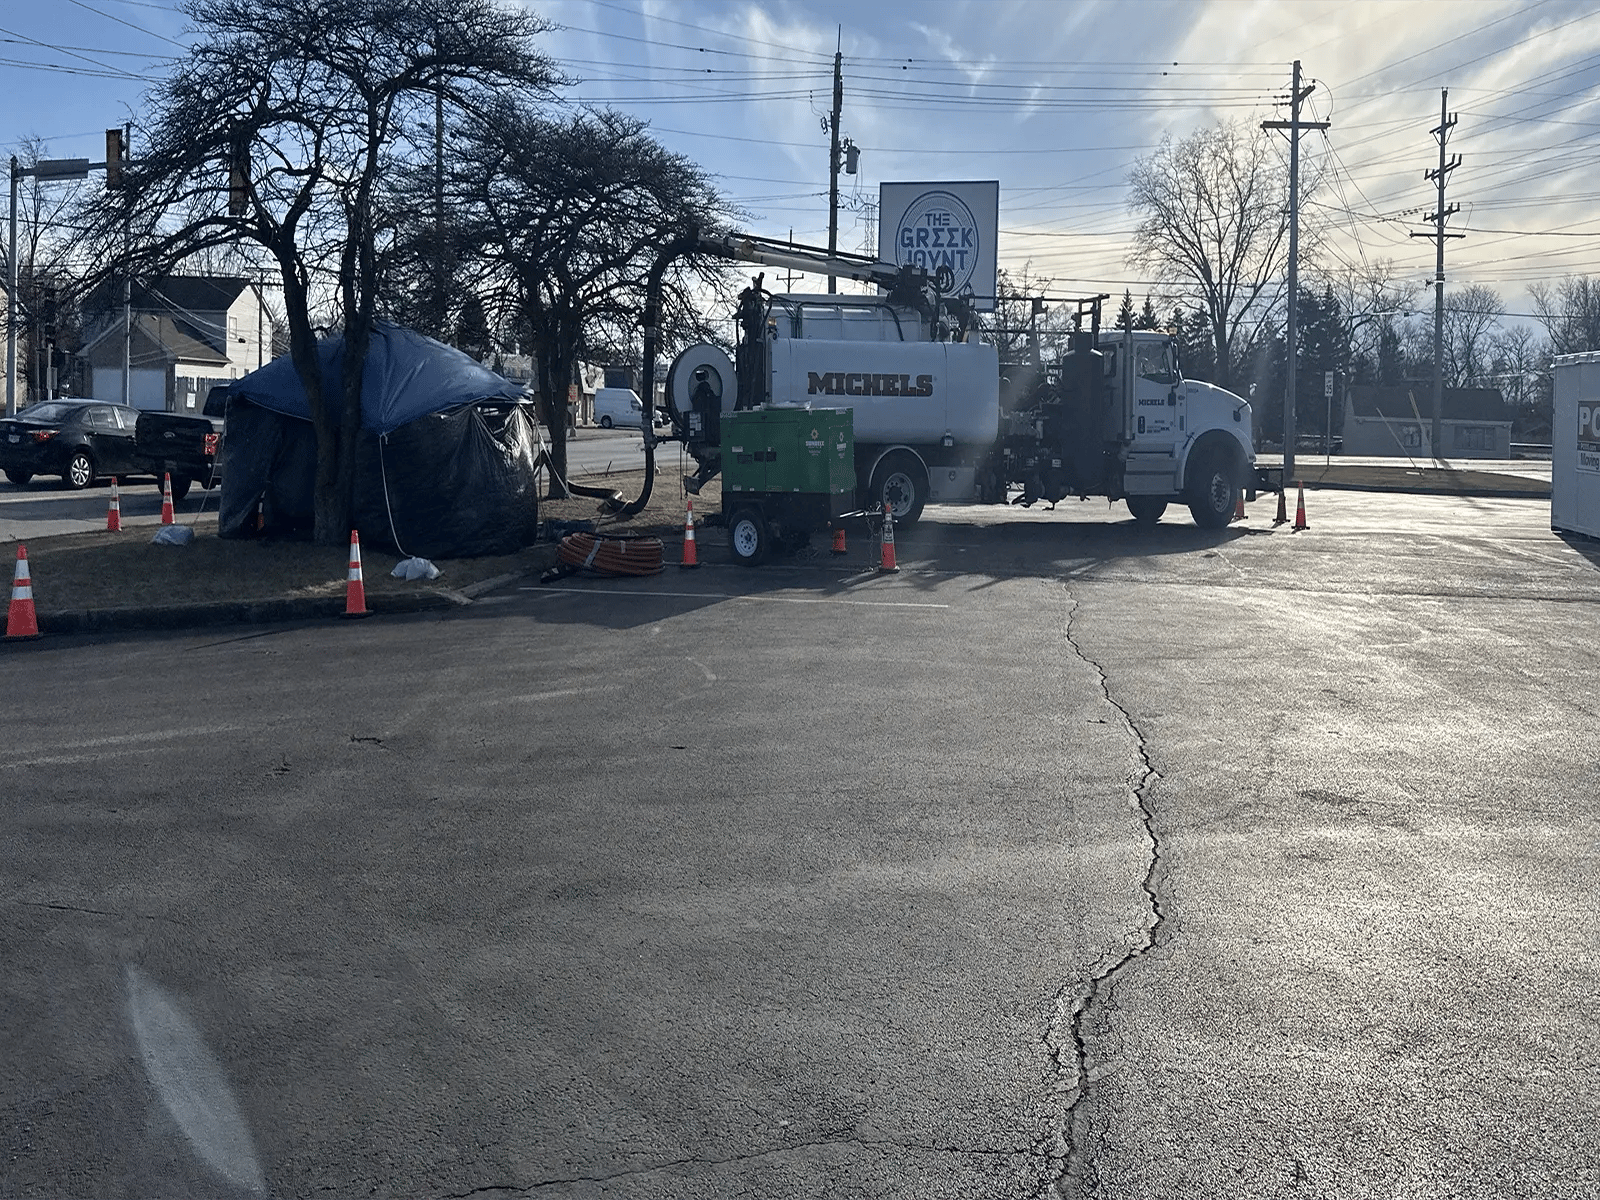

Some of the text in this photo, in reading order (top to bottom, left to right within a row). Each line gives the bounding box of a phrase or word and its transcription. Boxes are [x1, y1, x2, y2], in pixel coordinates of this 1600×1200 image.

[925, 213, 950, 226] THE
[808, 372, 933, 397] MICHELS
[1580, 453, 1600, 471] Moving
